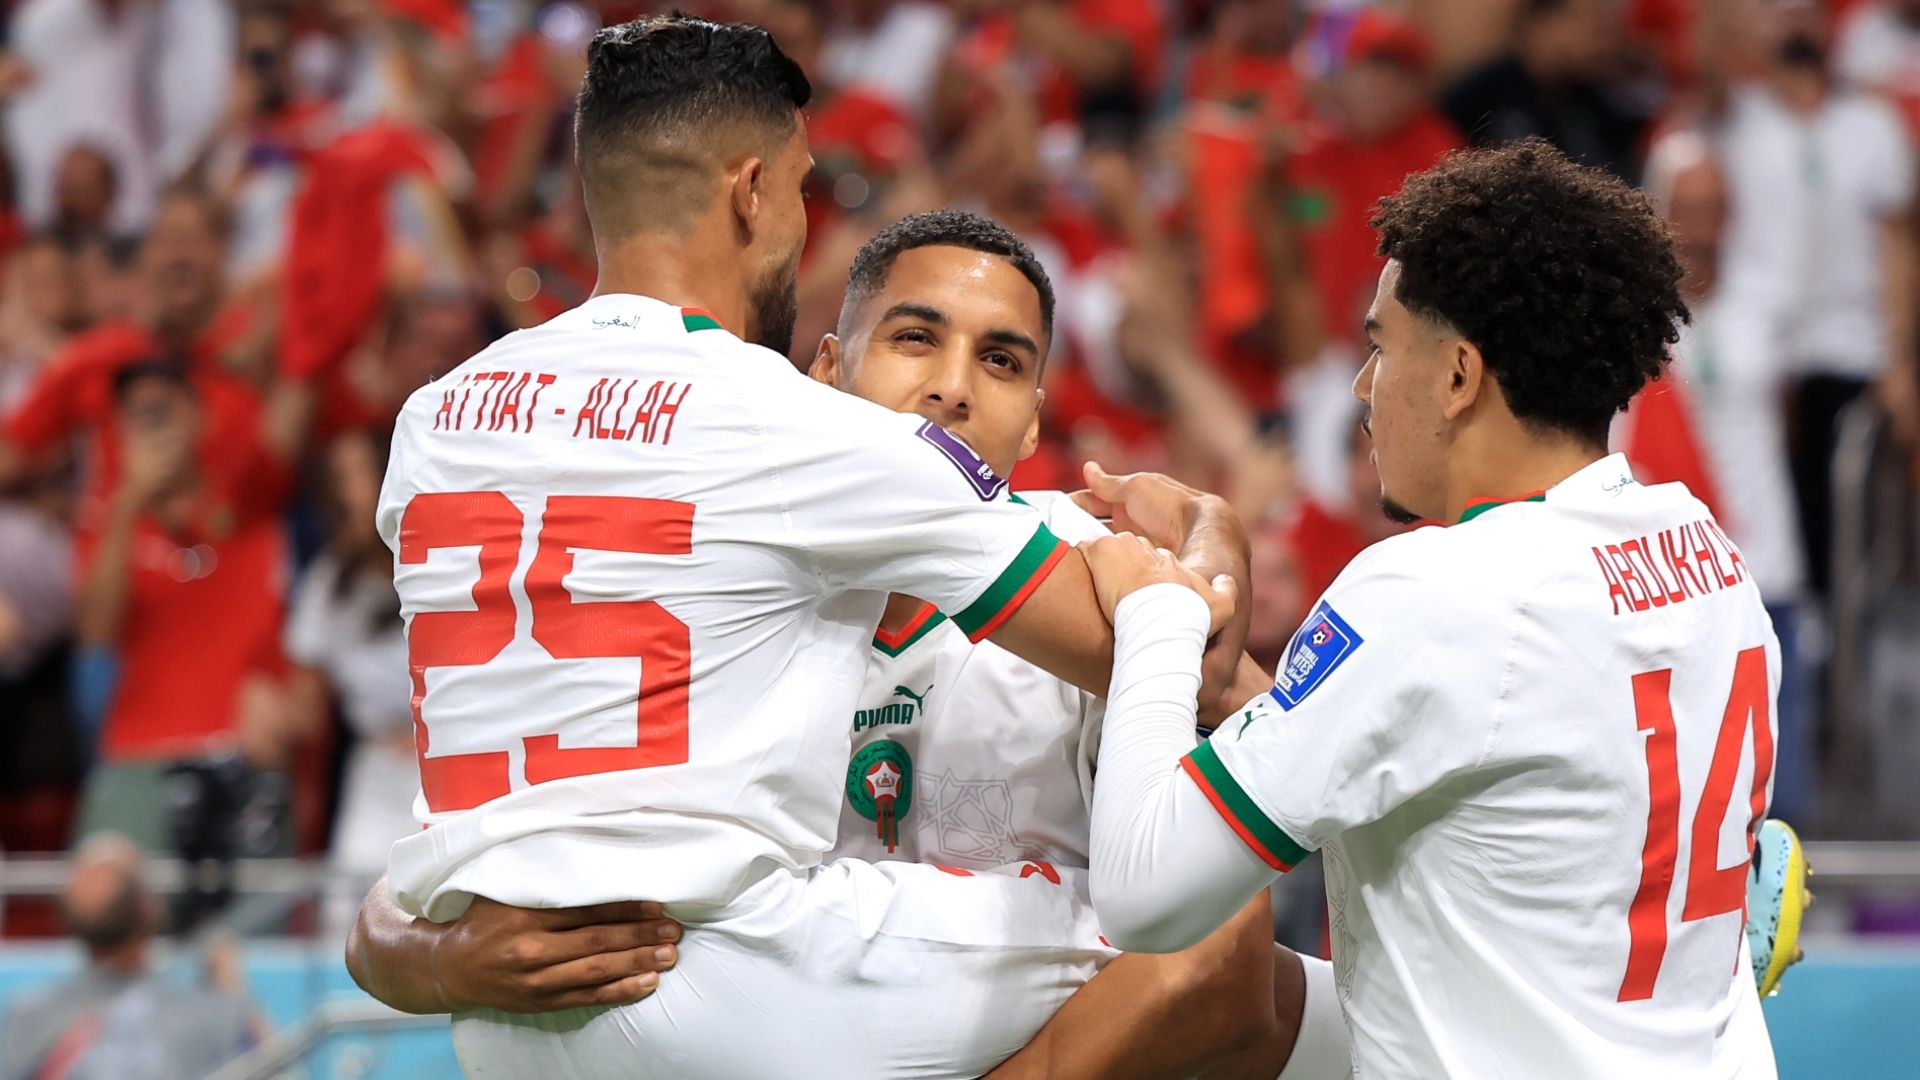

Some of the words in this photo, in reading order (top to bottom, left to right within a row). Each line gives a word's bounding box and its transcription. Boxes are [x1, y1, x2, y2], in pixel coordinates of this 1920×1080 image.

[592, 315, 641, 330] المغرب
[433, 371, 557, 434] ATTIAT
[573, 378, 693, 445] ALLAH
[399, 491, 697, 813] 25
[854, 704, 915, 732] PUMA
[1617, 645, 1774, 1002] 14
